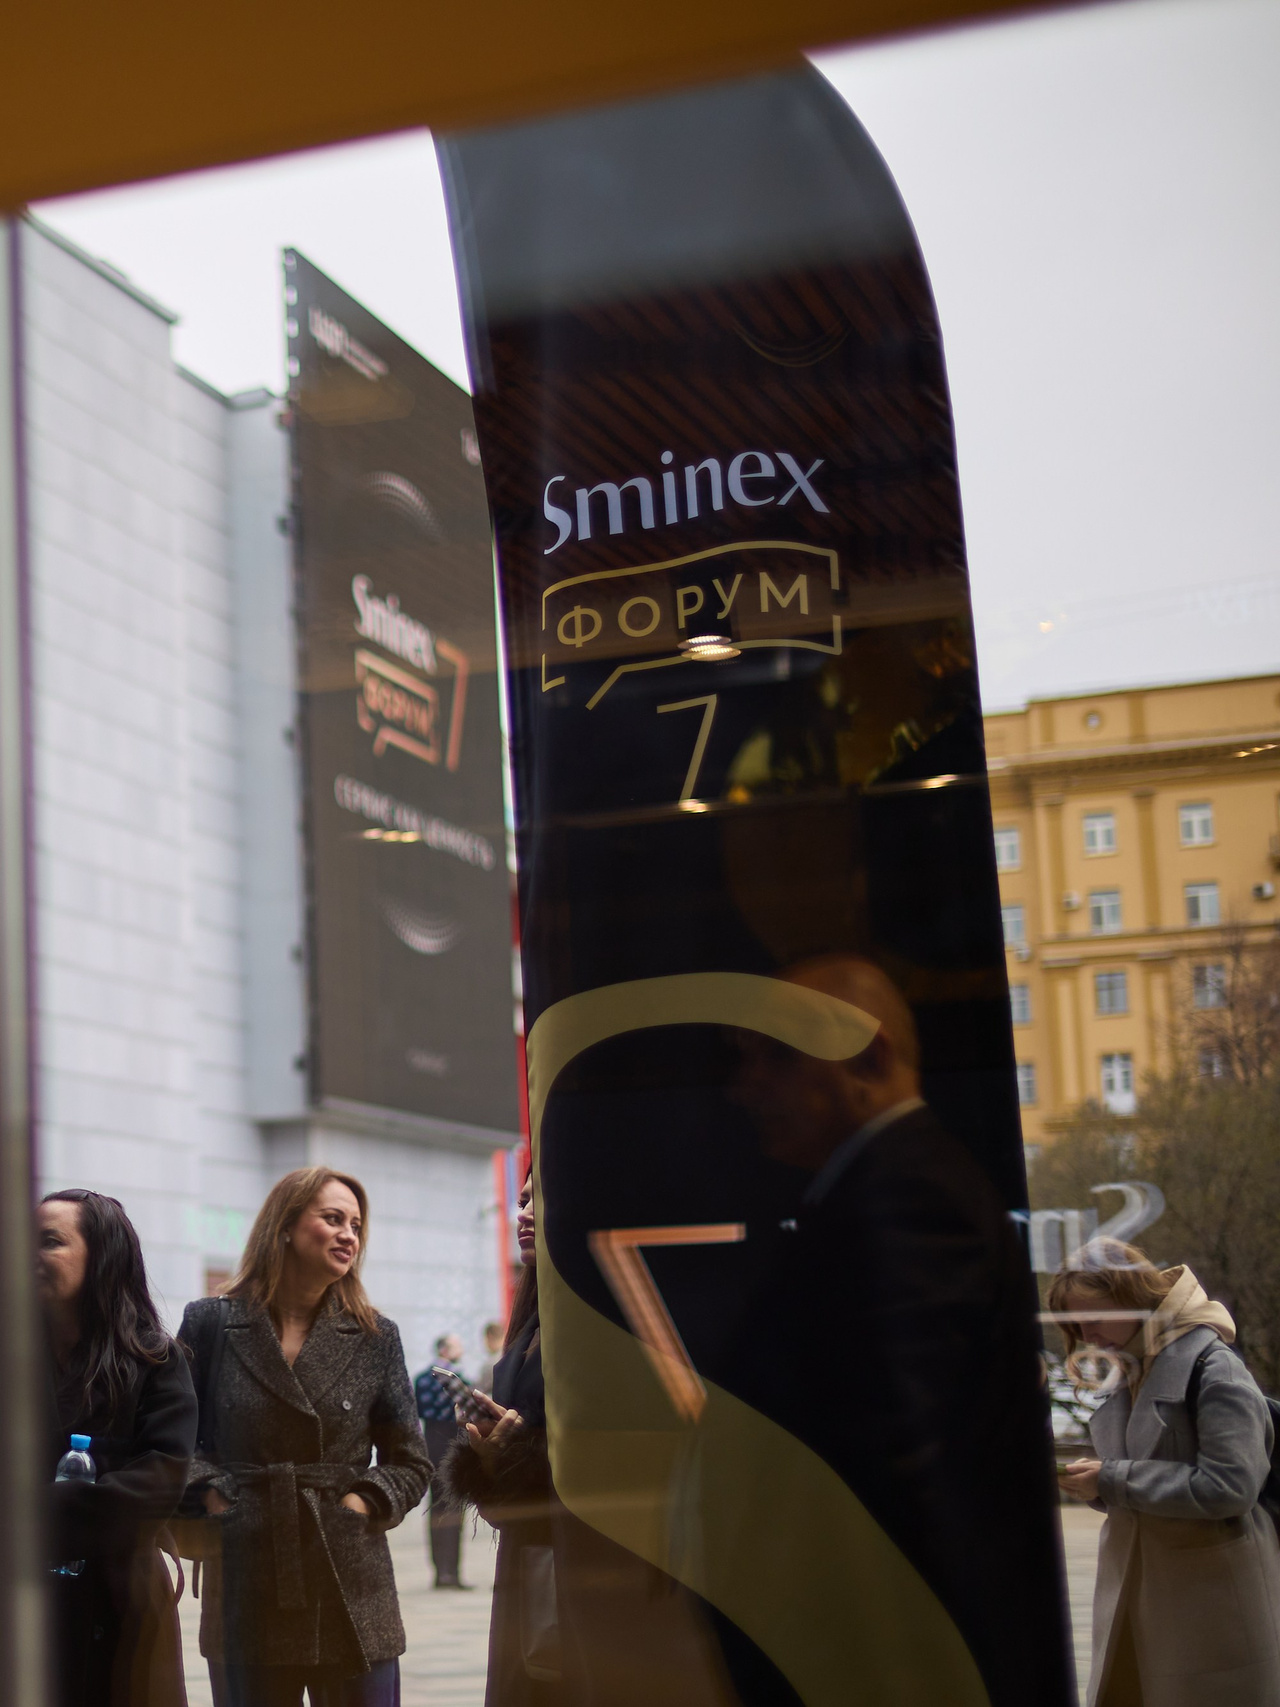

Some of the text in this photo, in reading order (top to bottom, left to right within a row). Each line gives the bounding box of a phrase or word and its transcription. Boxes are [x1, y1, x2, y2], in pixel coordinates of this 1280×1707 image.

[543, 450, 831, 555] Sminex
[352, 574, 437, 676] Sminex
[556, 571, 810, 648] ФОРУМ
[656, 694, 718, 808] 7
